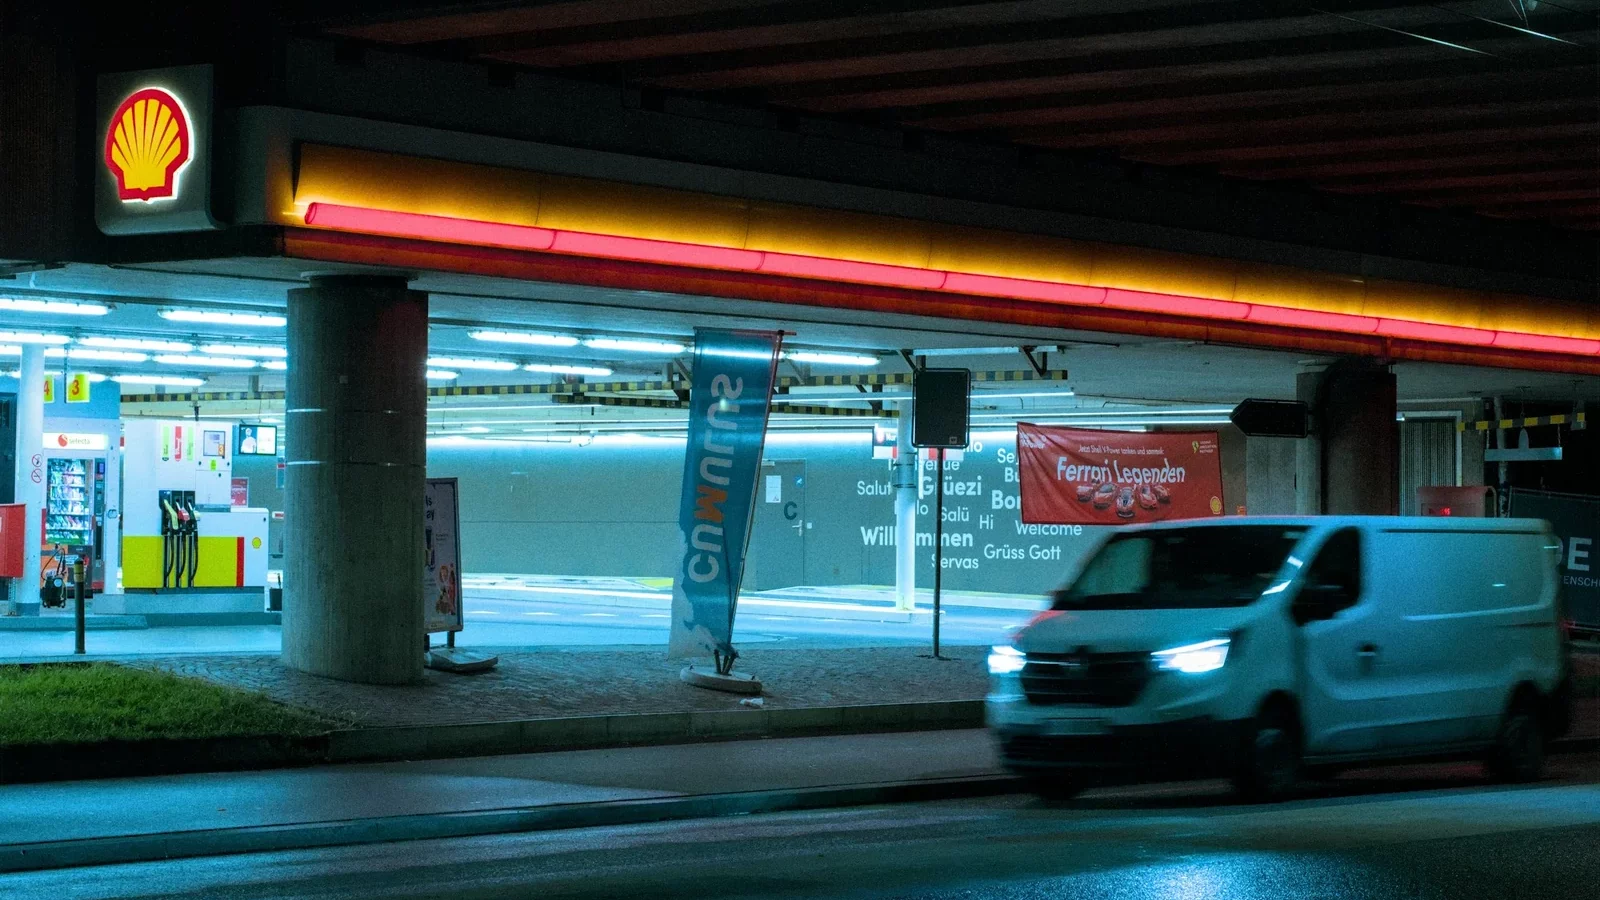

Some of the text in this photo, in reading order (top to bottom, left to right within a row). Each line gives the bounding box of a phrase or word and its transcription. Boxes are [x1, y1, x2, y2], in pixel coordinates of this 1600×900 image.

[71, 379, 80, 396] 3
[68, 436, 91, 446] selecta
[1056, 456, 1186, 487] Ferrari Legenden
[857, 480, 892, 496] Salut
[784, 501, 798, 520] C
[941, 506, 970, 522] Salü
[979, 514, 994, 530] Hi
[1014, 520, 1082, 536] Welcome
[860, 525, 974, 547] Willmmen
[983, 544, 1061, 561] Grüss Gott
